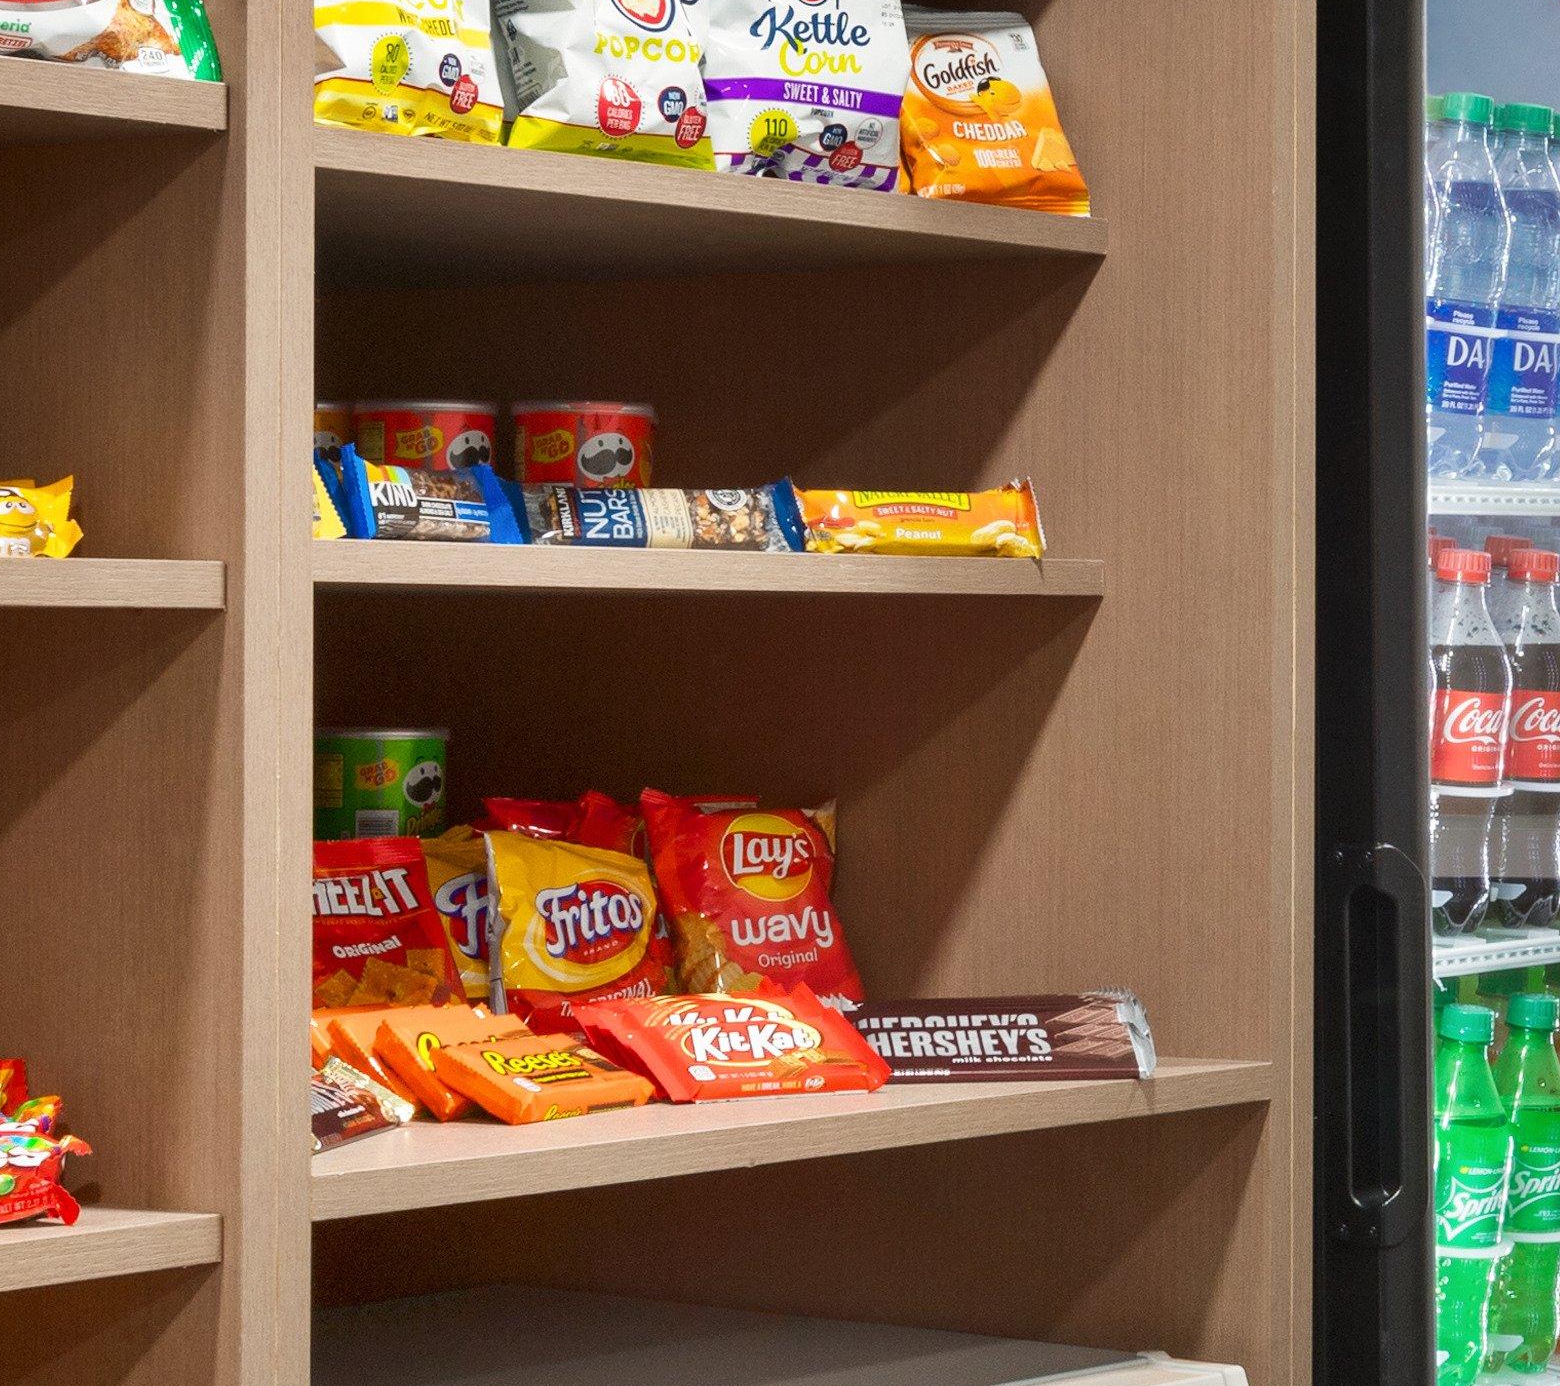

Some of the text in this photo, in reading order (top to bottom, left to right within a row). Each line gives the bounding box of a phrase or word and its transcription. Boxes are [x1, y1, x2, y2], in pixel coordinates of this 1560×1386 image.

[750, 6, 871, 52] Kettle
[779, 39, 862, 78] Corn
[923, 53, 999, 90] Goldfish
[453, 91, 476, 111] FREE
[664, 100, 684, 114] GMO
[783, 82, 863, 109] SWEET & SALTY
[678, 124, 700, 141] FREE
[765, 118, 788, 136] 110
[953, 120, 1028, 142] CHEDDAR
[823, 133, 844, 147] GMO
[832, 153, 857, 170] FREE
[369, 481, 418, 508] KIND
[876, 506, 905, 516] SWEET
[895, 527, 943, 541] Peanut
[731, 831, 812, 880] Lay's
[535, 877, 643, 961] Fritos
[731, 905, 834, 951] wavy
[757, 948, 820, 971] Original
[875, 1028, 1053, 1058] HERSHEY'S
[483, 1048, 584, 1076] Reese's
[951, 1053, 1054, 1064] milk chocolate
